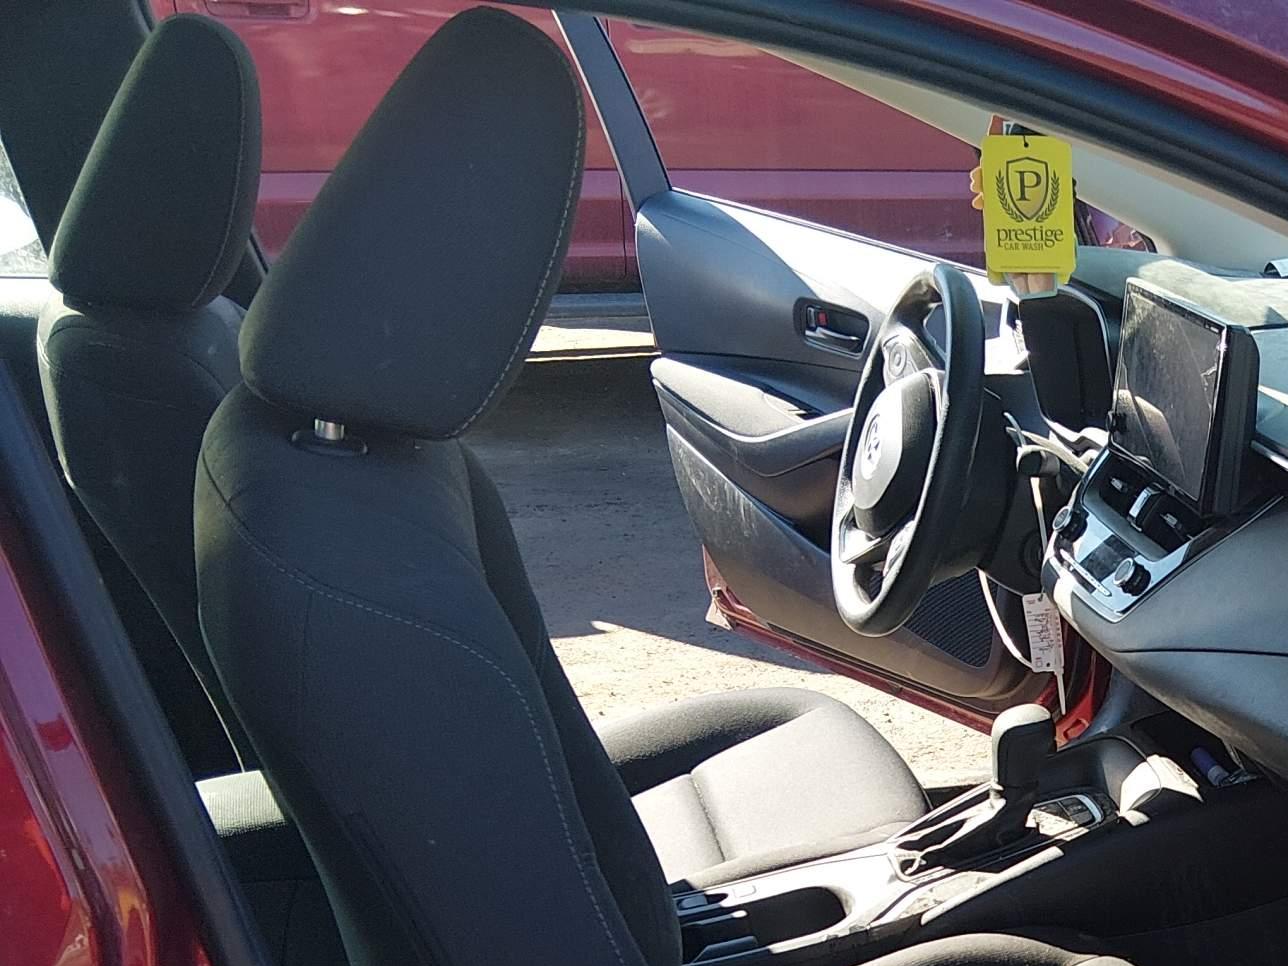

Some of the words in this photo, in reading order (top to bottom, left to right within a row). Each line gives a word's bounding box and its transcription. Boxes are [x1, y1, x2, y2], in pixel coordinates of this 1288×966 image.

[1015, 170, 1042, 201] P
[996, 226, 1064, 248] prestige
[1004, 242, 1020, 250] CAR
[1022, 242, 1044, 251] WASH
